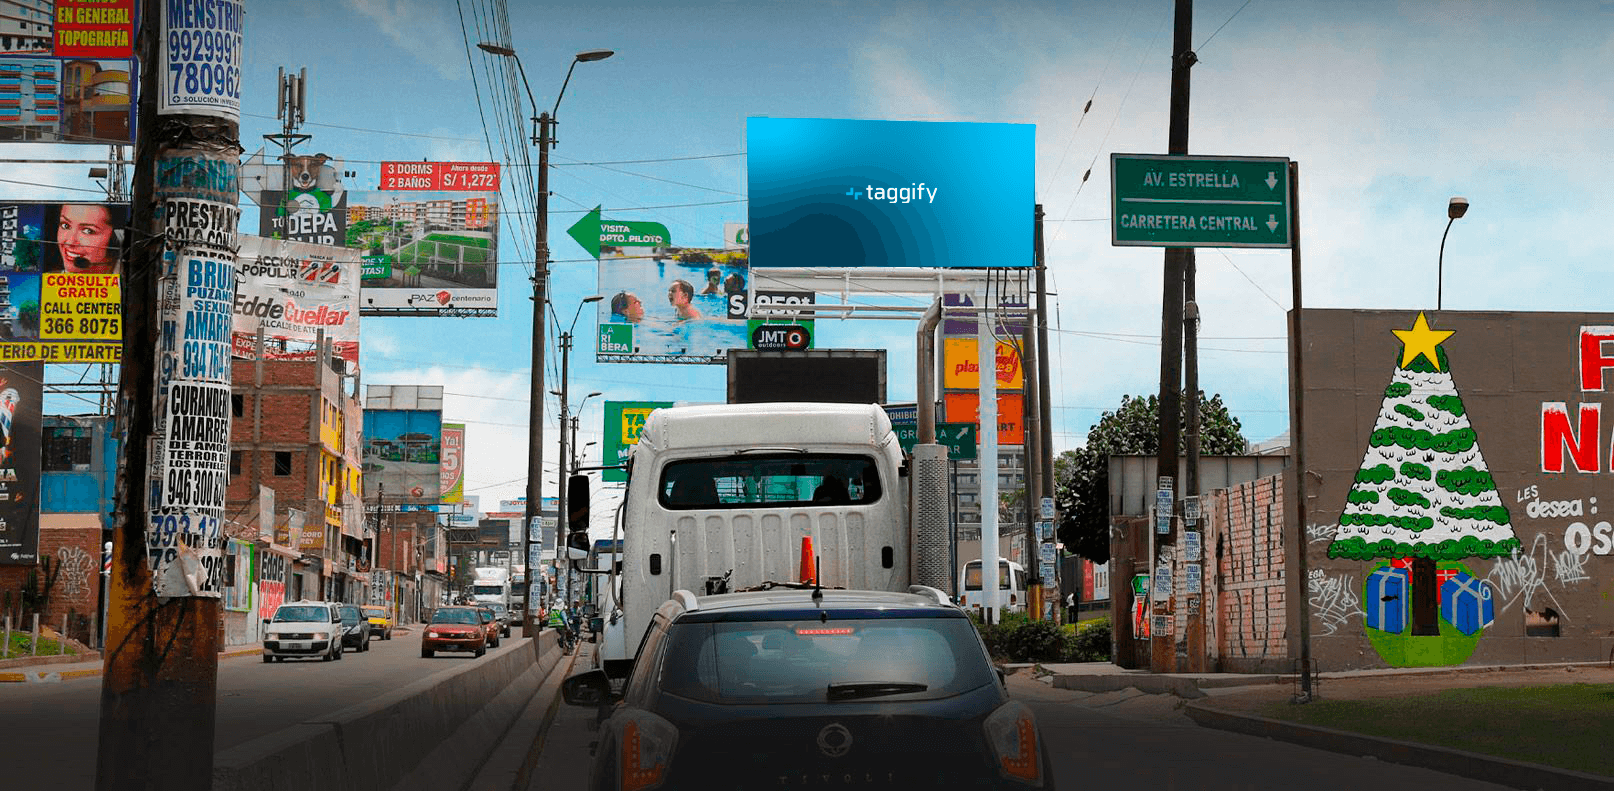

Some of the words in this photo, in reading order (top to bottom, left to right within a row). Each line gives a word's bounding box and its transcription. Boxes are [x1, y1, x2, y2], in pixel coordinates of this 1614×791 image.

[59, 7, 73, 24] EN
[77, 8, 130, 24] GENERAL
[59, 28, 129, 47] TOPOGRAFÍA
[388, 164, 395, 174] 3
[398, 164, 432, 175] DORMS
[388, 178, 395, 188] 2
[398, 175, 431, 188] BAÑOS
[1144, 171, 1164, 187] AV.
[1169, 173, 1240, 188] ESTRELLA
[866, 182, 939, 204] taggify
[289, 213, 337, 235] DEPA
[600, 224, 630, 233] VISITA
[1120, 214, 1197, 230] CARRETERA
[1200, 216, 1258, 231] CENTRAL
[629, 235, 663, 244] PILOTO
[242, 264, 297, 279] POPULAR
[47, 275, 120, 287] CONSULTA
[58, 287, 109, 299] GRATIS
[411, 294, 435, 302] PAZ
[44, 302, 73, 315] CALL
[76, 302, 121, 315] CENTER
[44, 317, 74, 334] 366
[80, 317, 119, 335] 8075
[759, 330, 787, 343] JMT
[41, 345, 60, 359] DE
[63, 345, 122, 360] VITARTE
[1579, 325, 1614, 392] F
[171, 385, 229, 419] CURANDER
[169, 441, 190, 450] DE
[168, 450, 218, 462] TERROR
[169, 460, 191, 468] LOS
[167, 468, 192, 505] 946
[1517, 484, 1539, 503] LES
[1526, 497, 1584, 518] desea
[1564, 521, 1614, 556] OS
